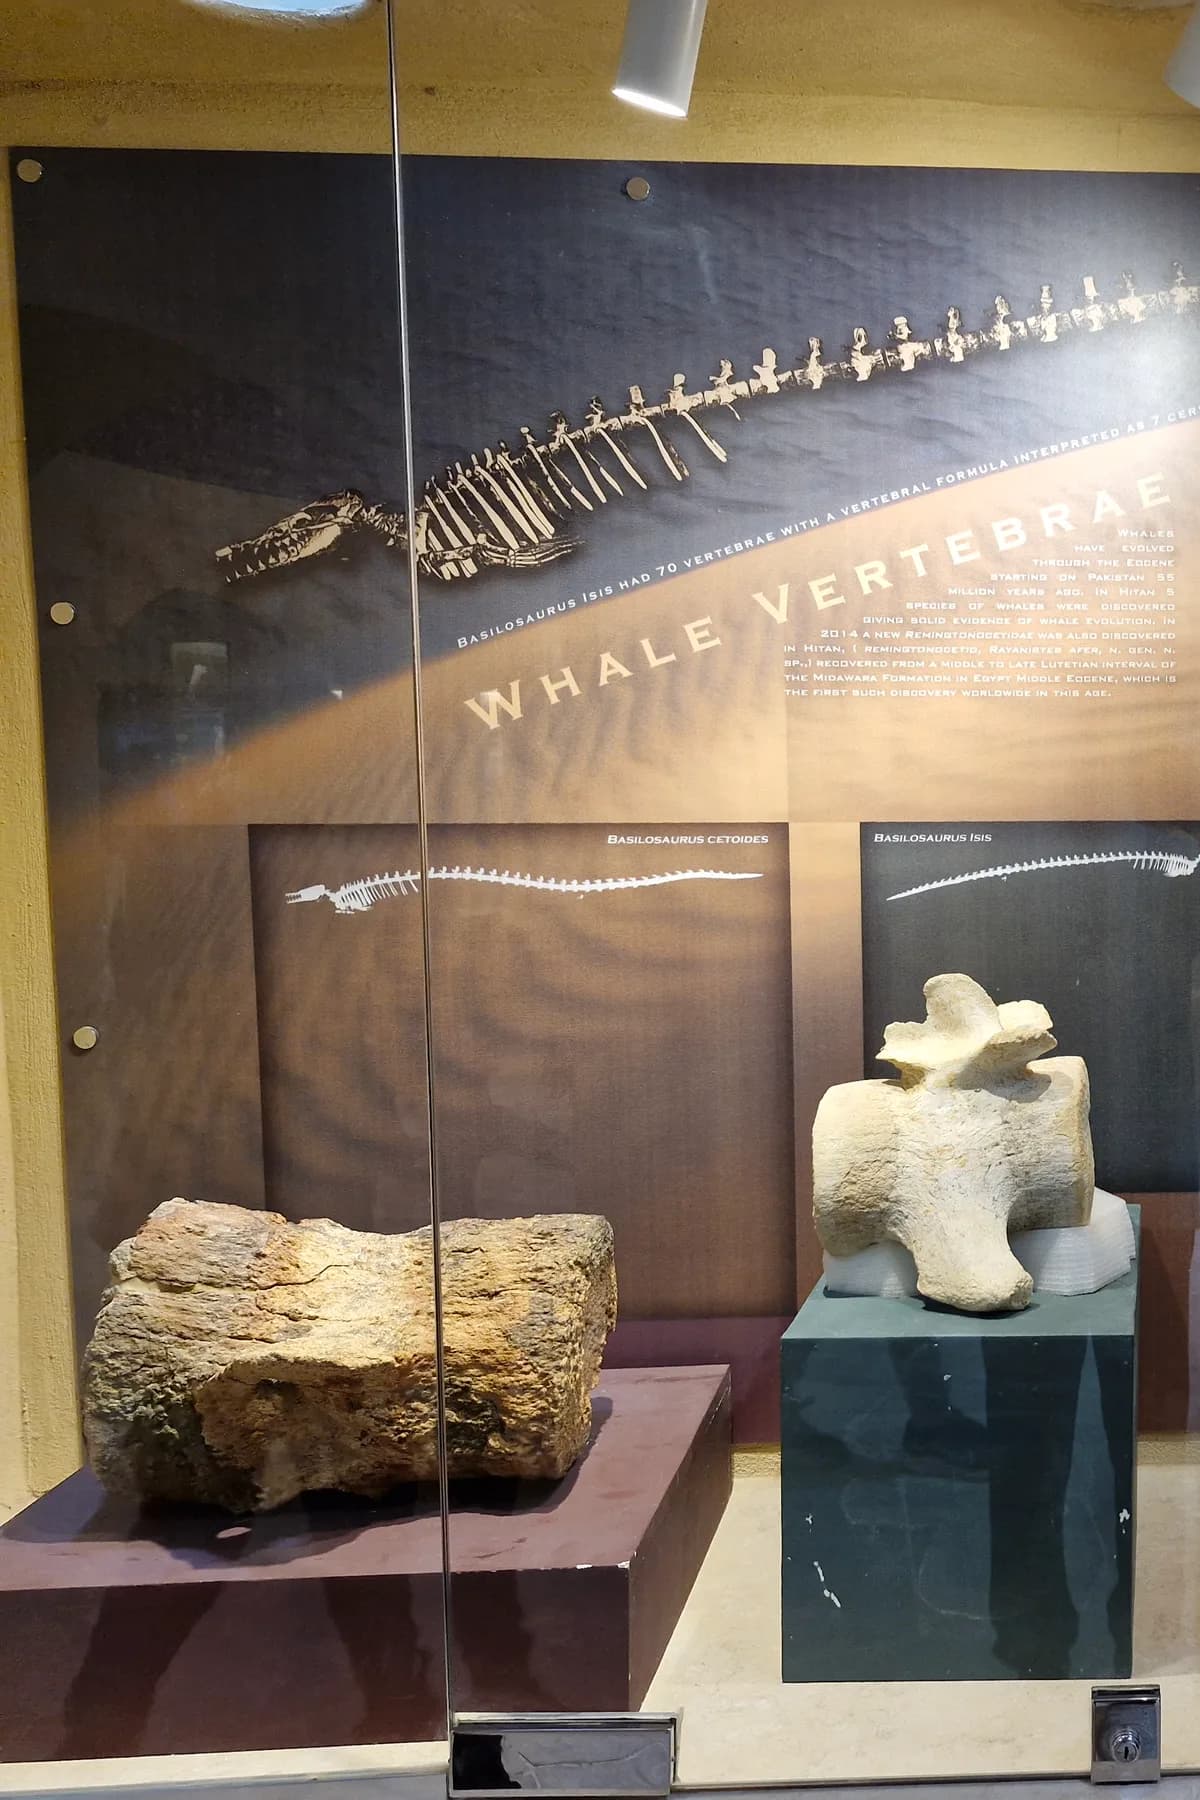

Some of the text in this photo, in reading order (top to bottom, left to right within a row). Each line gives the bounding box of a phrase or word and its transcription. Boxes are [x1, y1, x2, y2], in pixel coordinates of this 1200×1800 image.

[456, 598, 577, 650] BASILOSAURUS
[582, 585, 614, 603] ISIS
[620, 572, 652, 590] HAD
[656, 562, 678, 577] 70
[684, 532, 776, 569] VERTEBRAE
[781, 517, 820, 537] WITH
[826, 512, 837, 523] A
[840, 481, 932, 518] VERTEBRAL
[936, 458, 1009, 487] FORMULA
[1013, 428, 1120, 465] INTERPRETED
[1126, 421, 1146, 434] AS
[1151, 415, 1160, 427] 7
[1118, 528, 1175, 539] WHALES
[1073, 543, 1175, 553] HAVE EVOLVED
[1031, 558, 1176, 568] THROUGH THE EOCENE
[990, 572, 1048, 582] STARTING
[1057, 573, 1077, 582] ON
[1087, 572, 1145, 582] PAKISTAN
[947, 584, 996, 596] MILLION
[1006, 587, 1046, 597] YEARS
[1095, 587, 1109, 596] IN
[1119, 587, 1156, 597] HITAN
[463, 471, 1173, 732] WHALE VERTEBRAE
[905, 599, 1176, 612] SPECIES OF WHALES WERE DISCOVERED
[862, 615, 904, 625] GIVING
[910, 615, 947, 625] SOLID
[952, 616, 1012, 625] EVIDENCE
[1016, 617, 1033, 625] OF
[1039, 617, 1080, 625] WHALE
[1162, 616, 1176, 625] IN
[819, 628, 1176, 641] 2014 A NEW REMINGTONOCETIDAE WAS ALSO DISCOVERED
[783, 643, 800, 653] IN
[815, 657, 1177, 669] RECOVERED FROM A MIDDLE TO LATE LUTETIAN INTERVAL OF
[783, 673, 809, 682] THE
[881, 673, 952, 683] FORMATION
[955, 674, 969, 683] IN
[973, 673, 1012, 683] EGYPT
[1015, 673, 1061, 684] MIDDLE
[1122, 674, 1161, 684] WHICH
[1164, 674, 1177, 684] IS
[783, 688, 809, 697] THE
[812, 687, 849, 697] FIRST
[851, 688, 886, 697] SUCH
[889, 688, 958, 697] DISCOVERY
[960, 688, 1032, 698] WORLDWIDE
[1035, 689, 1049, 697] IN
[1052, 687, 1080, 697] THIS
[606, 833, 770, 846] BASILOSAURUS CETOIDES
[873, 832, 994, 844] BASILOSAURUS ISIS
